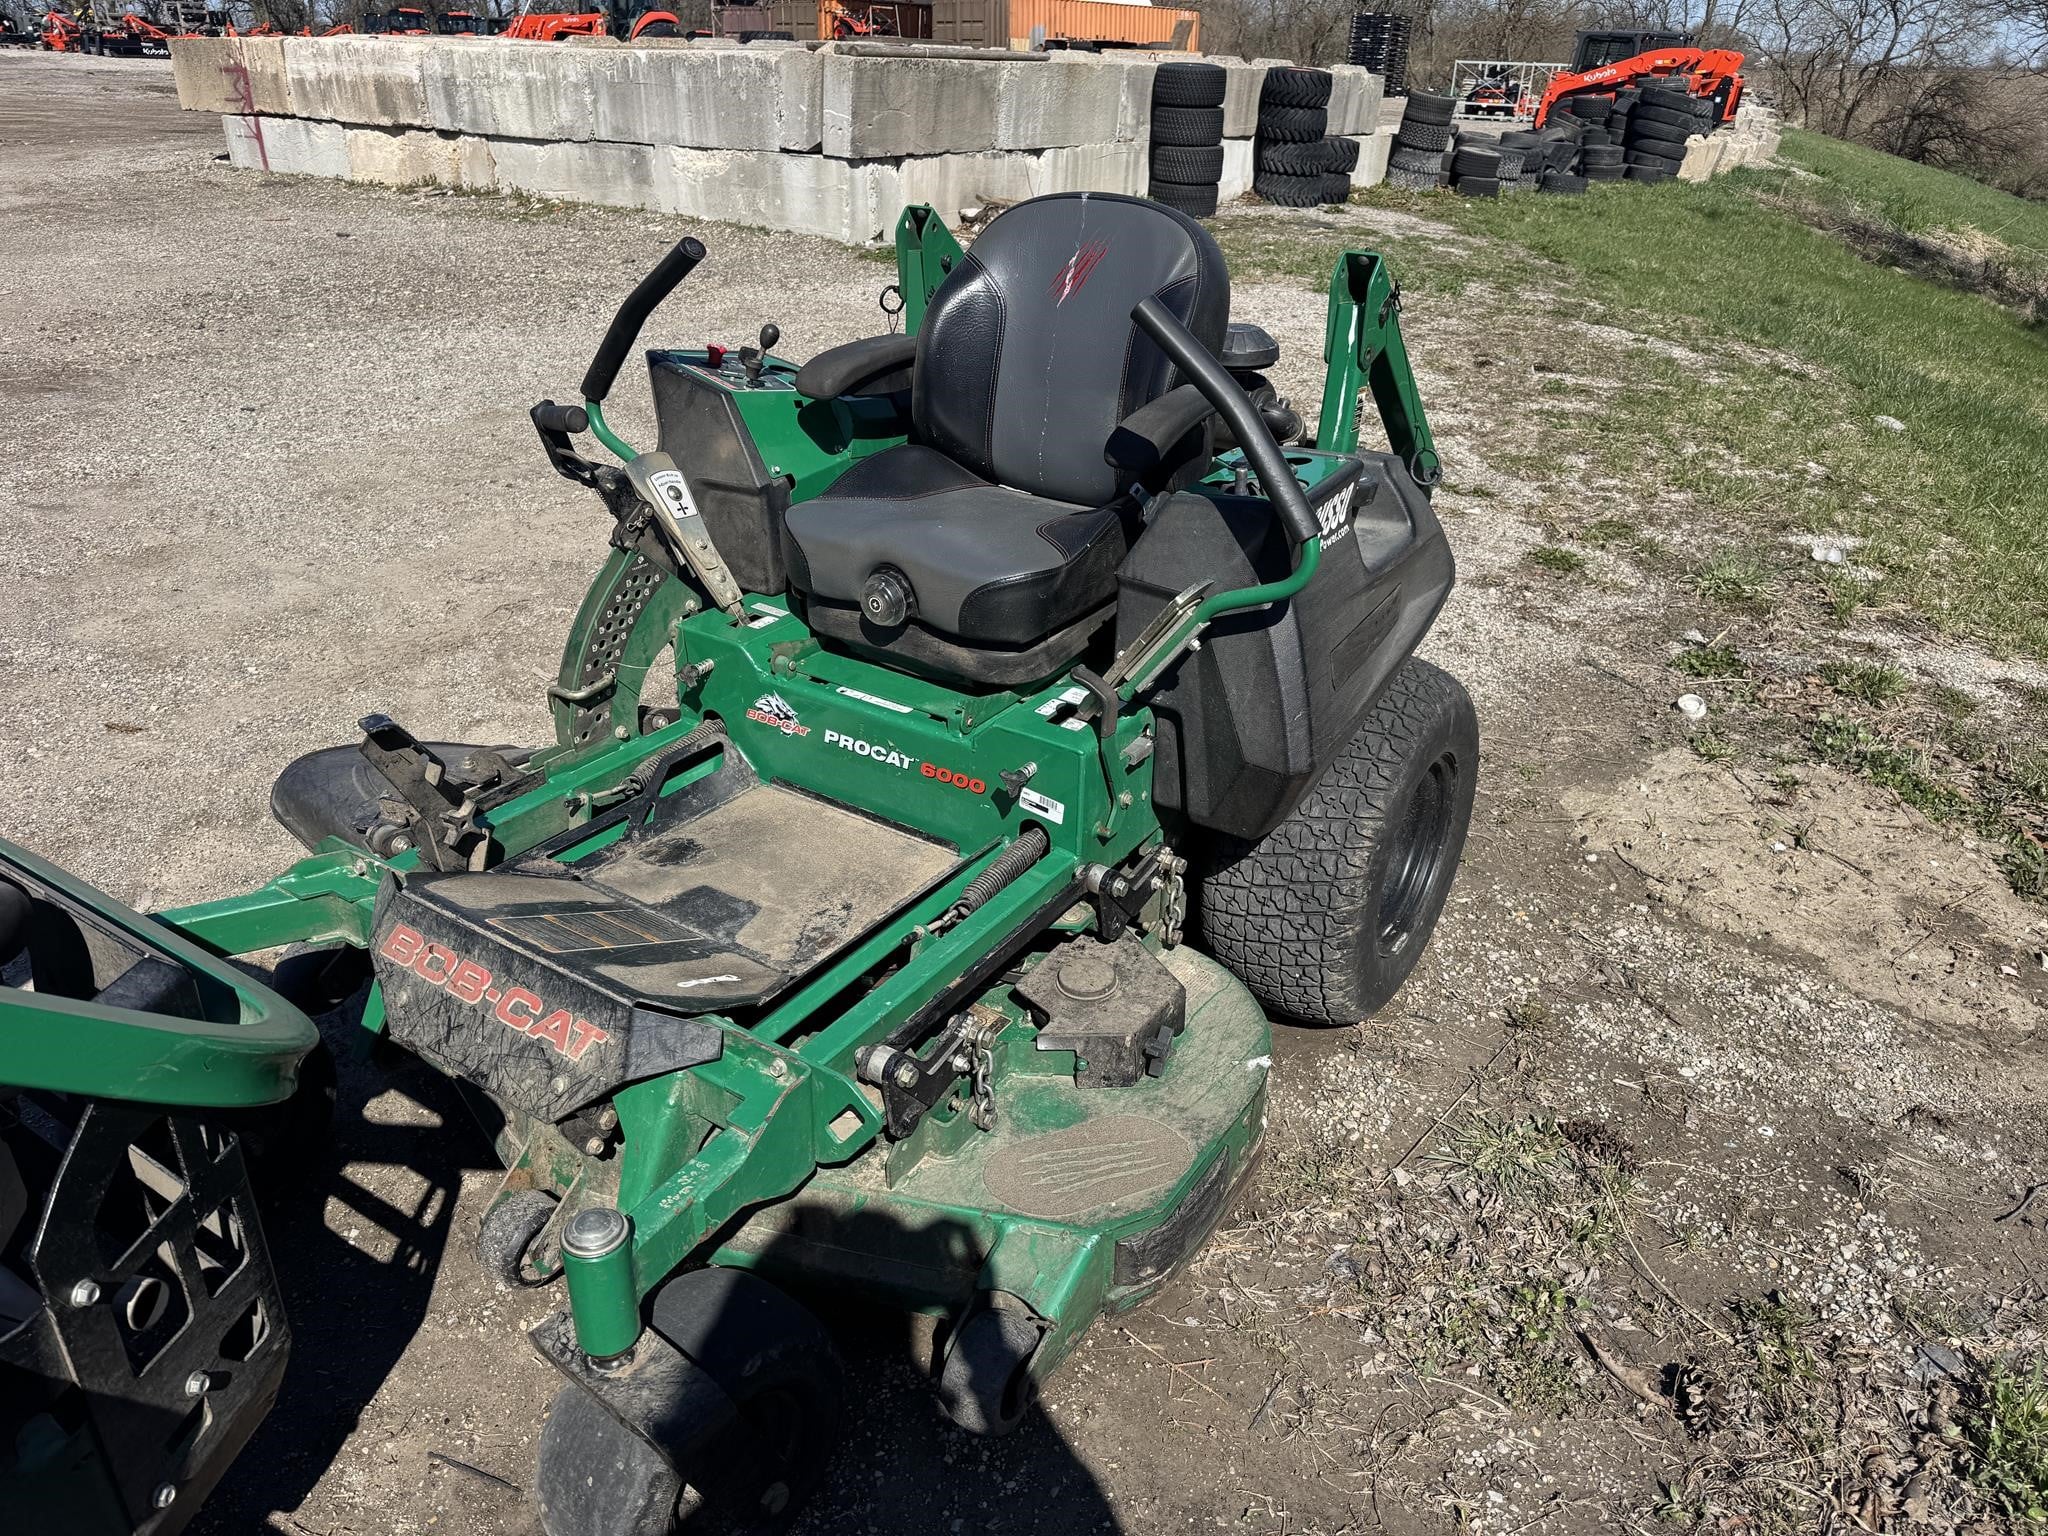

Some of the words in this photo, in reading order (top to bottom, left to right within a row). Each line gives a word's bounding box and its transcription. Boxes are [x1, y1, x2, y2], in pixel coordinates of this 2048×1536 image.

[1583, 68, 1617, 82] Kubota
[746, 709, 810, 737] BOB-CAT
[824, 729, 914, 770] PROCAT
[920, 762, 986, 794] 6000
[379, 923, 610, 1062] BOB-CAT
